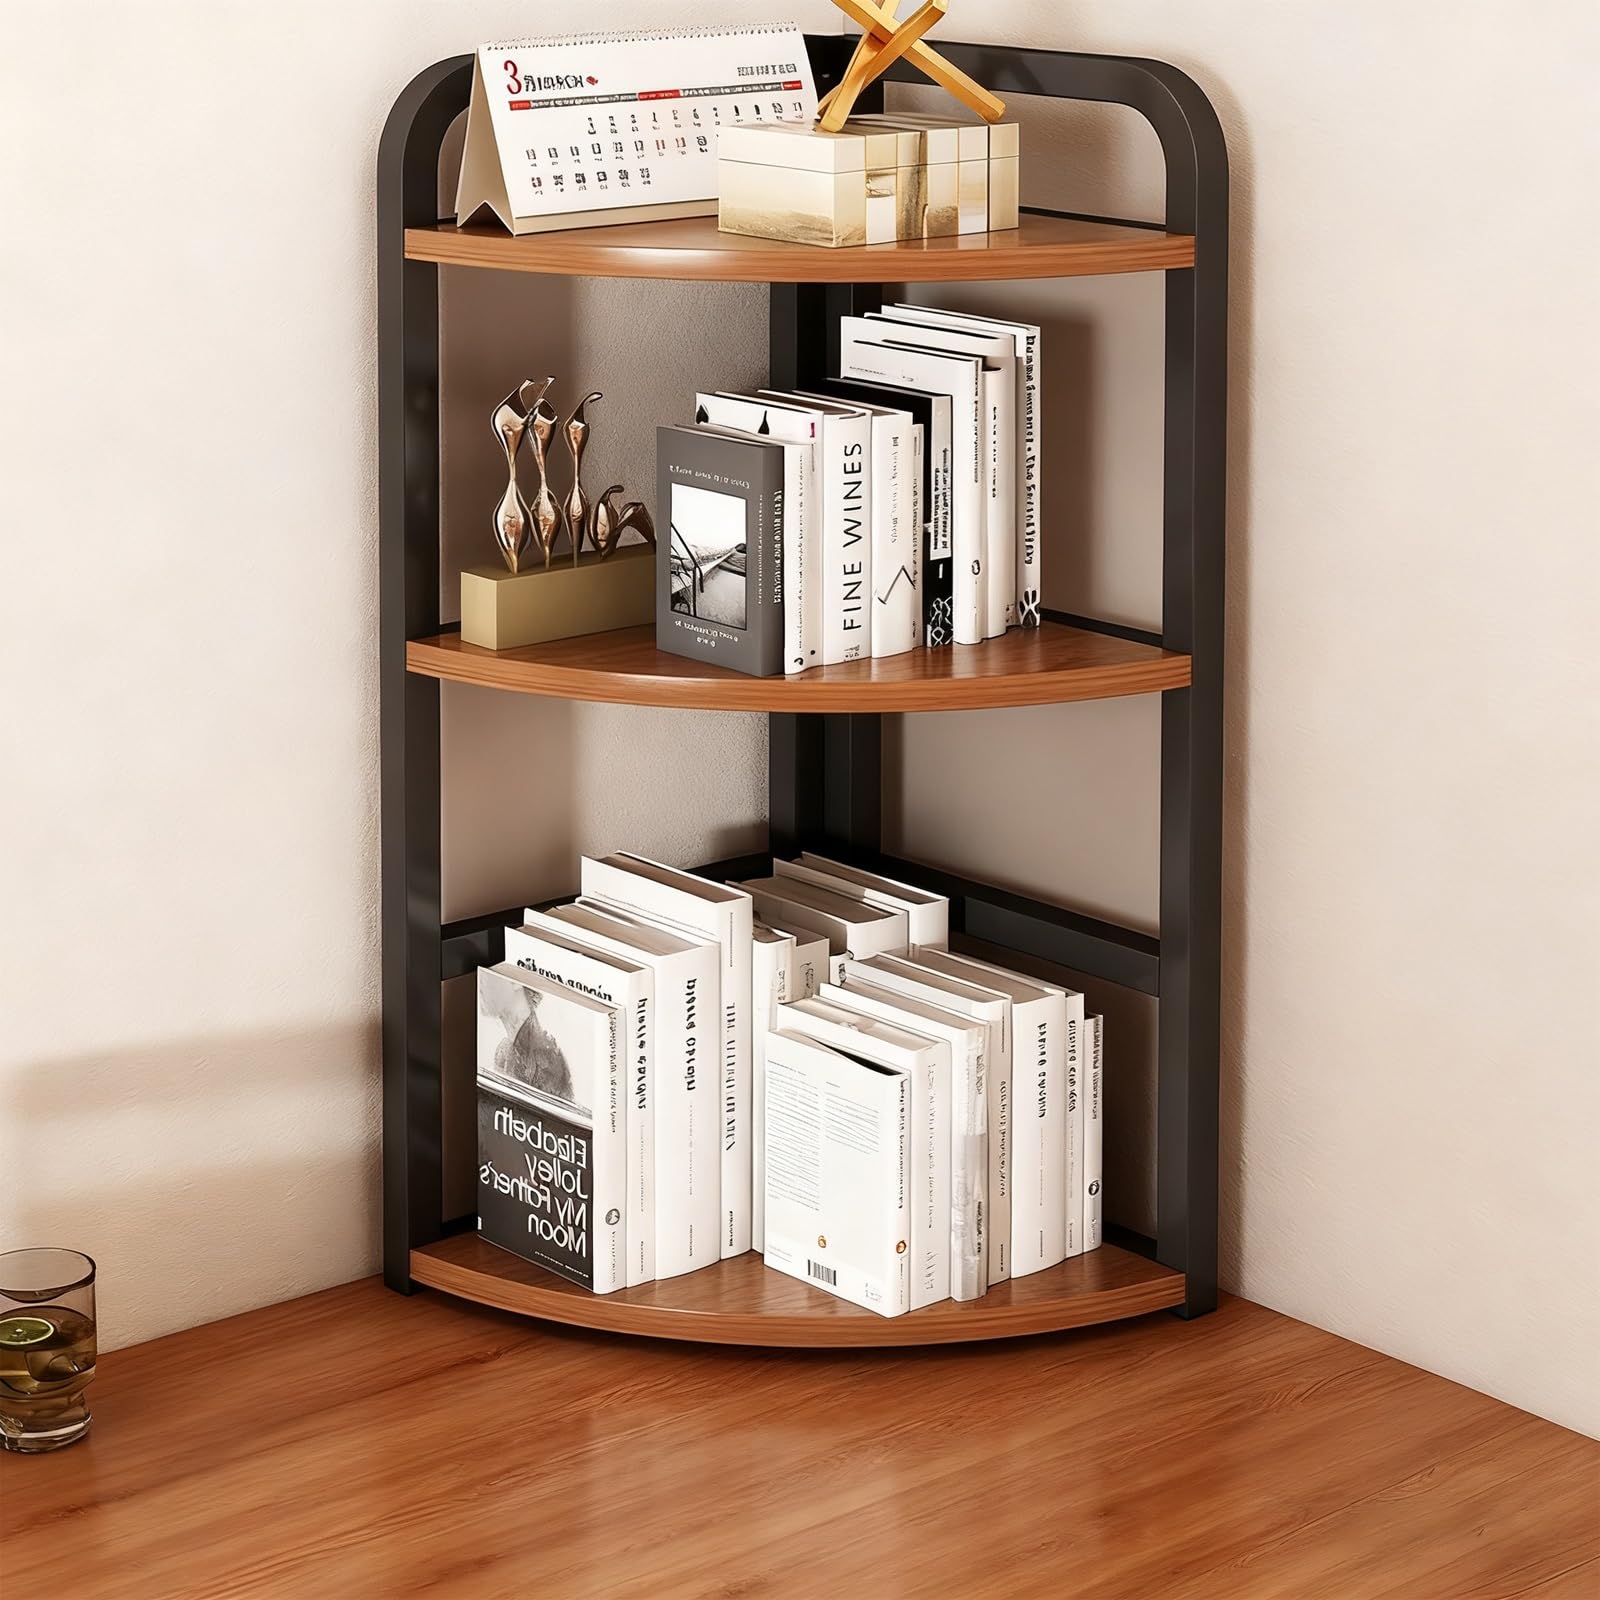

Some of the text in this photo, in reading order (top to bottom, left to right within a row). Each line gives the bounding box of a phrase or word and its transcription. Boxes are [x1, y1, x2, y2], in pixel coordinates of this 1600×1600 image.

[504, 60, 522, 94] 3
[843, 443, 862, 547] WINES
[843, 561, 862, 632] FINE
